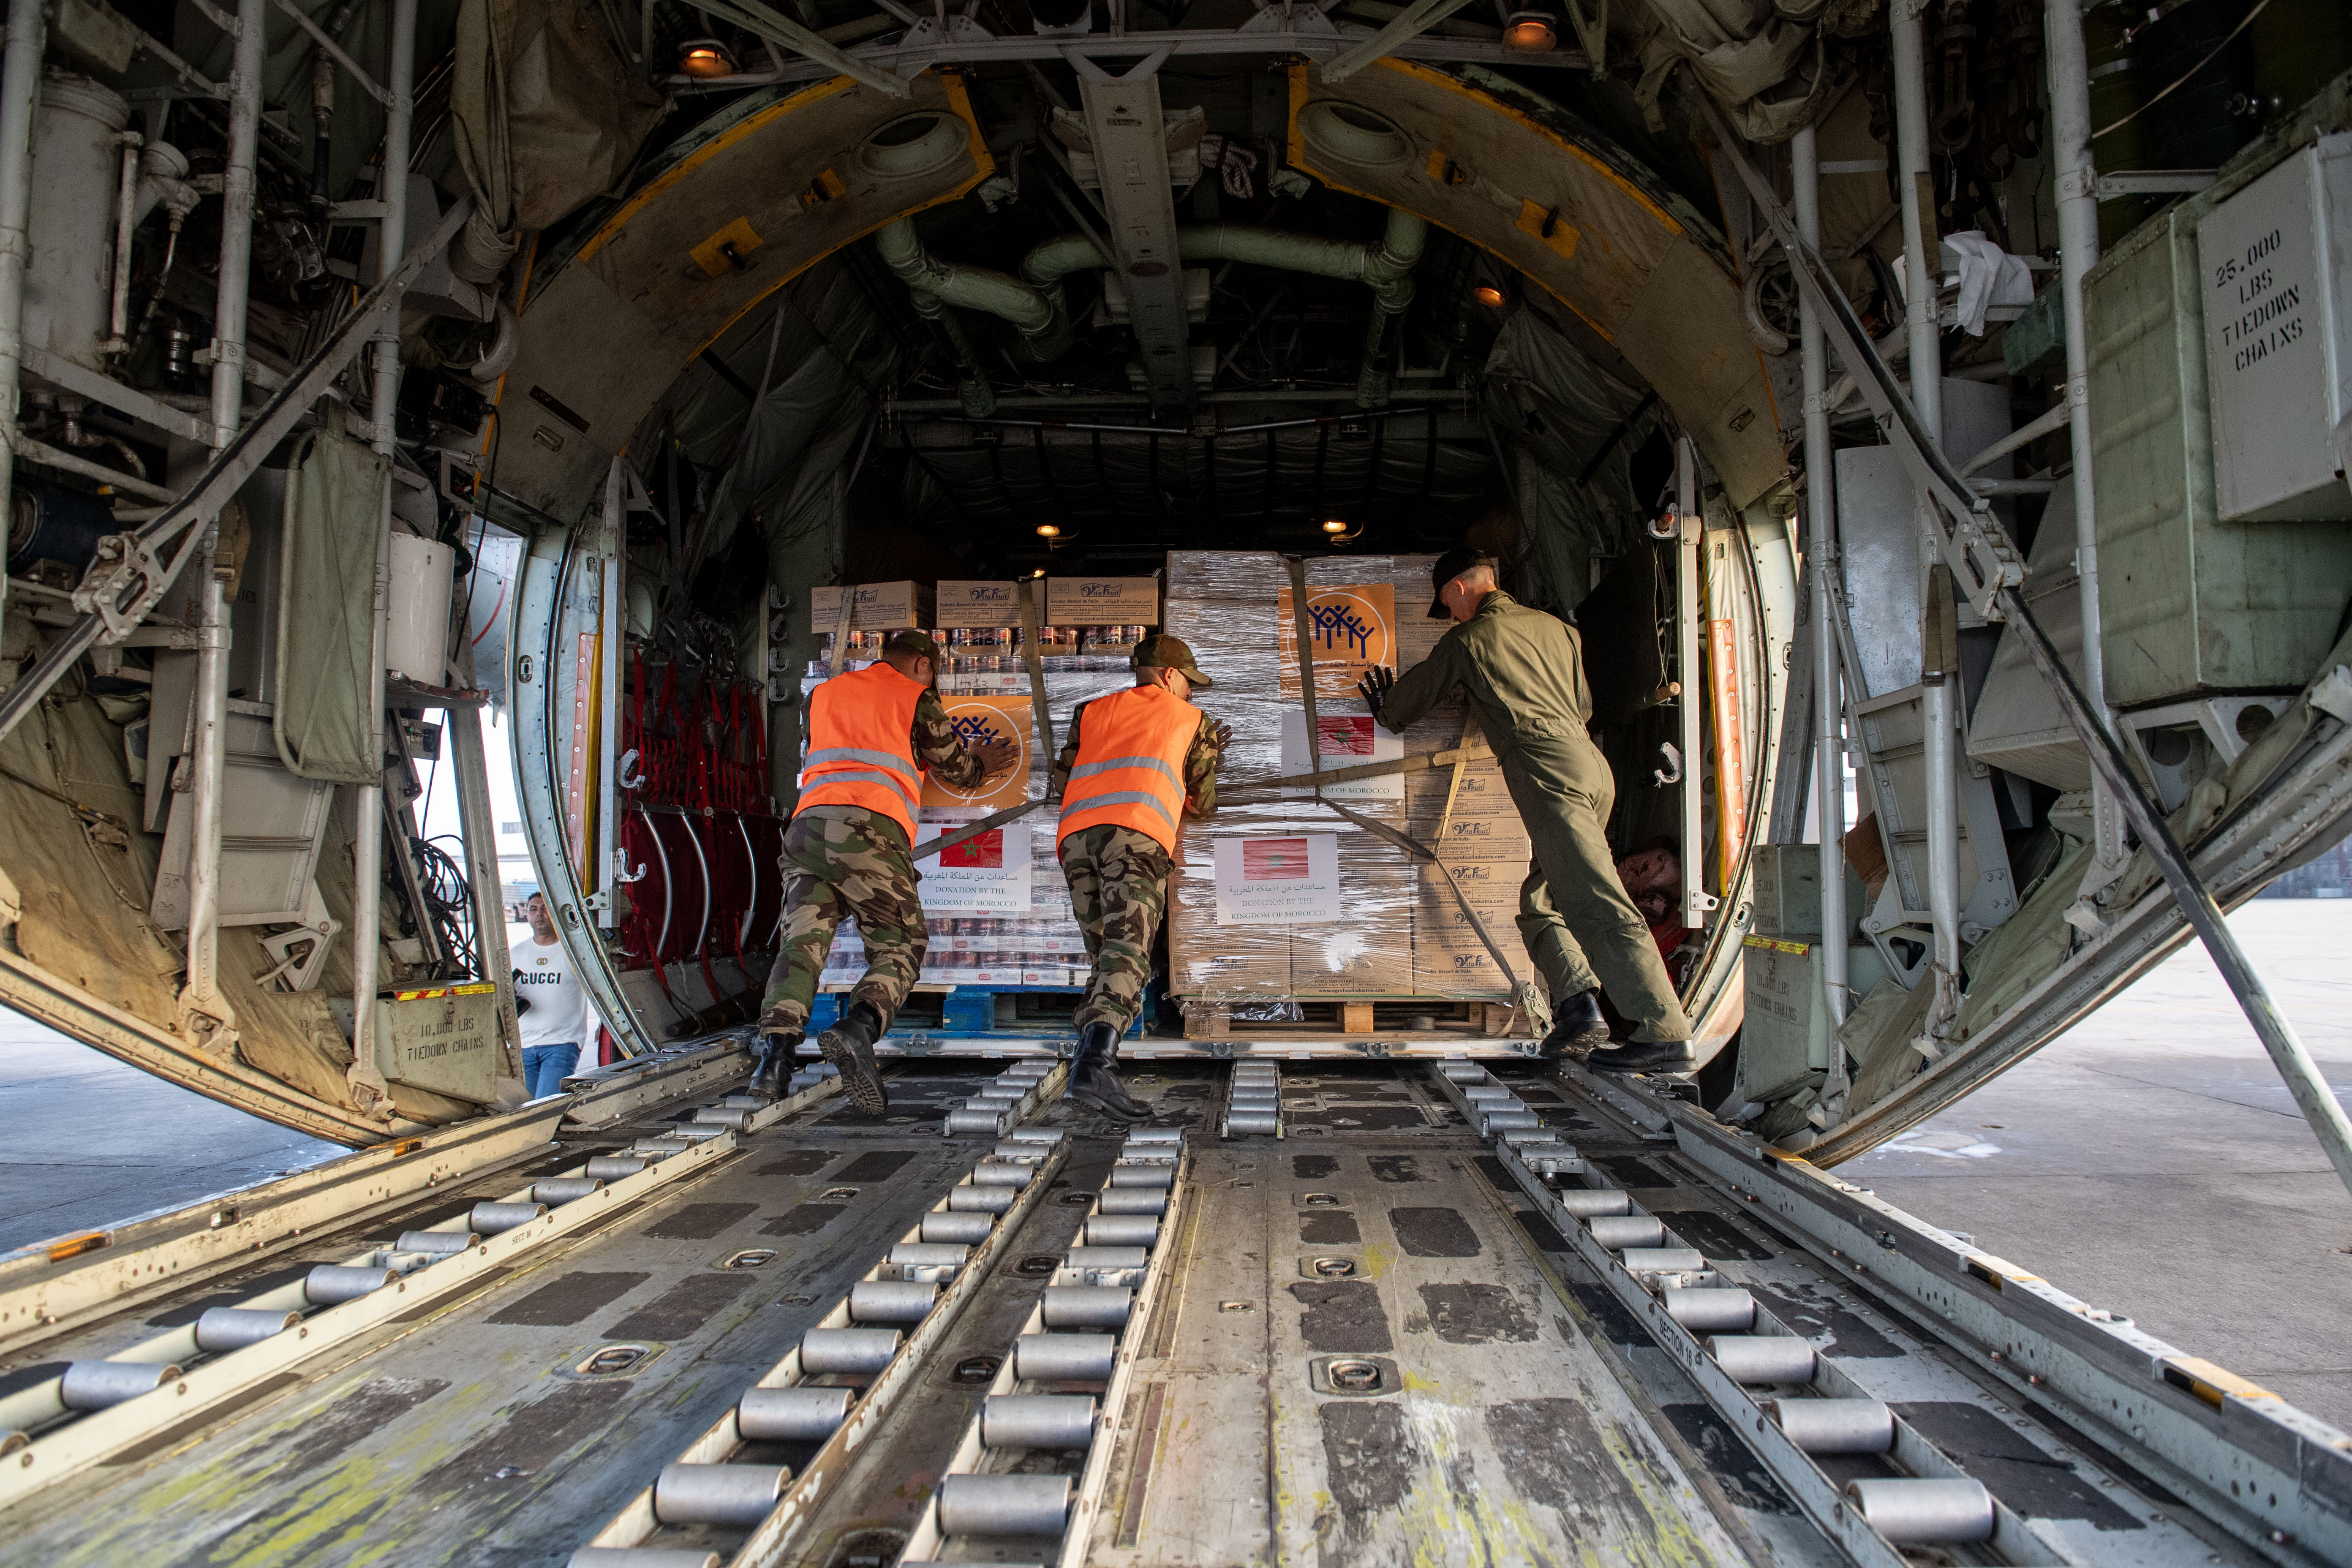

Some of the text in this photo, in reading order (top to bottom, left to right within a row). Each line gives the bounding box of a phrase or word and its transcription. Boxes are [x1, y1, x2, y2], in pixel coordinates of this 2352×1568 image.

[2216, 229, 2280, 287] 25.000
[2240, 268, 2272, 305] LBS
[2222, 284, 2299, 346] TIEDOWN
[2236, 318, 2303, 371] CHAINS
[1350, 660, 1375, 669] مؤسسة
[1376, 691, 1384, 707] HyFlex
[1453, 822, 1472, 834] Vita
[924, 871, 947, 881] المغربية
[1452, 867, 1471, 878] Vita
[1229, 886, 1253, 895] المغربية
[1242, 899, 1284, 907] DONATION
[1456, 955, 1474, 966] Vita
[521, 972, 561, 985] GUCCI
[1778, 980, 1789, 996] LBS
[1750, 991, 1796, 1021] TIEDOWN CHAINS
[421, 1017, 474, 1038] 10.000 LBS
[407, 1036, 483, 1062] TIEDOWN CHAINS
[1660, 1318, 1692, 1367] SECTION 16
